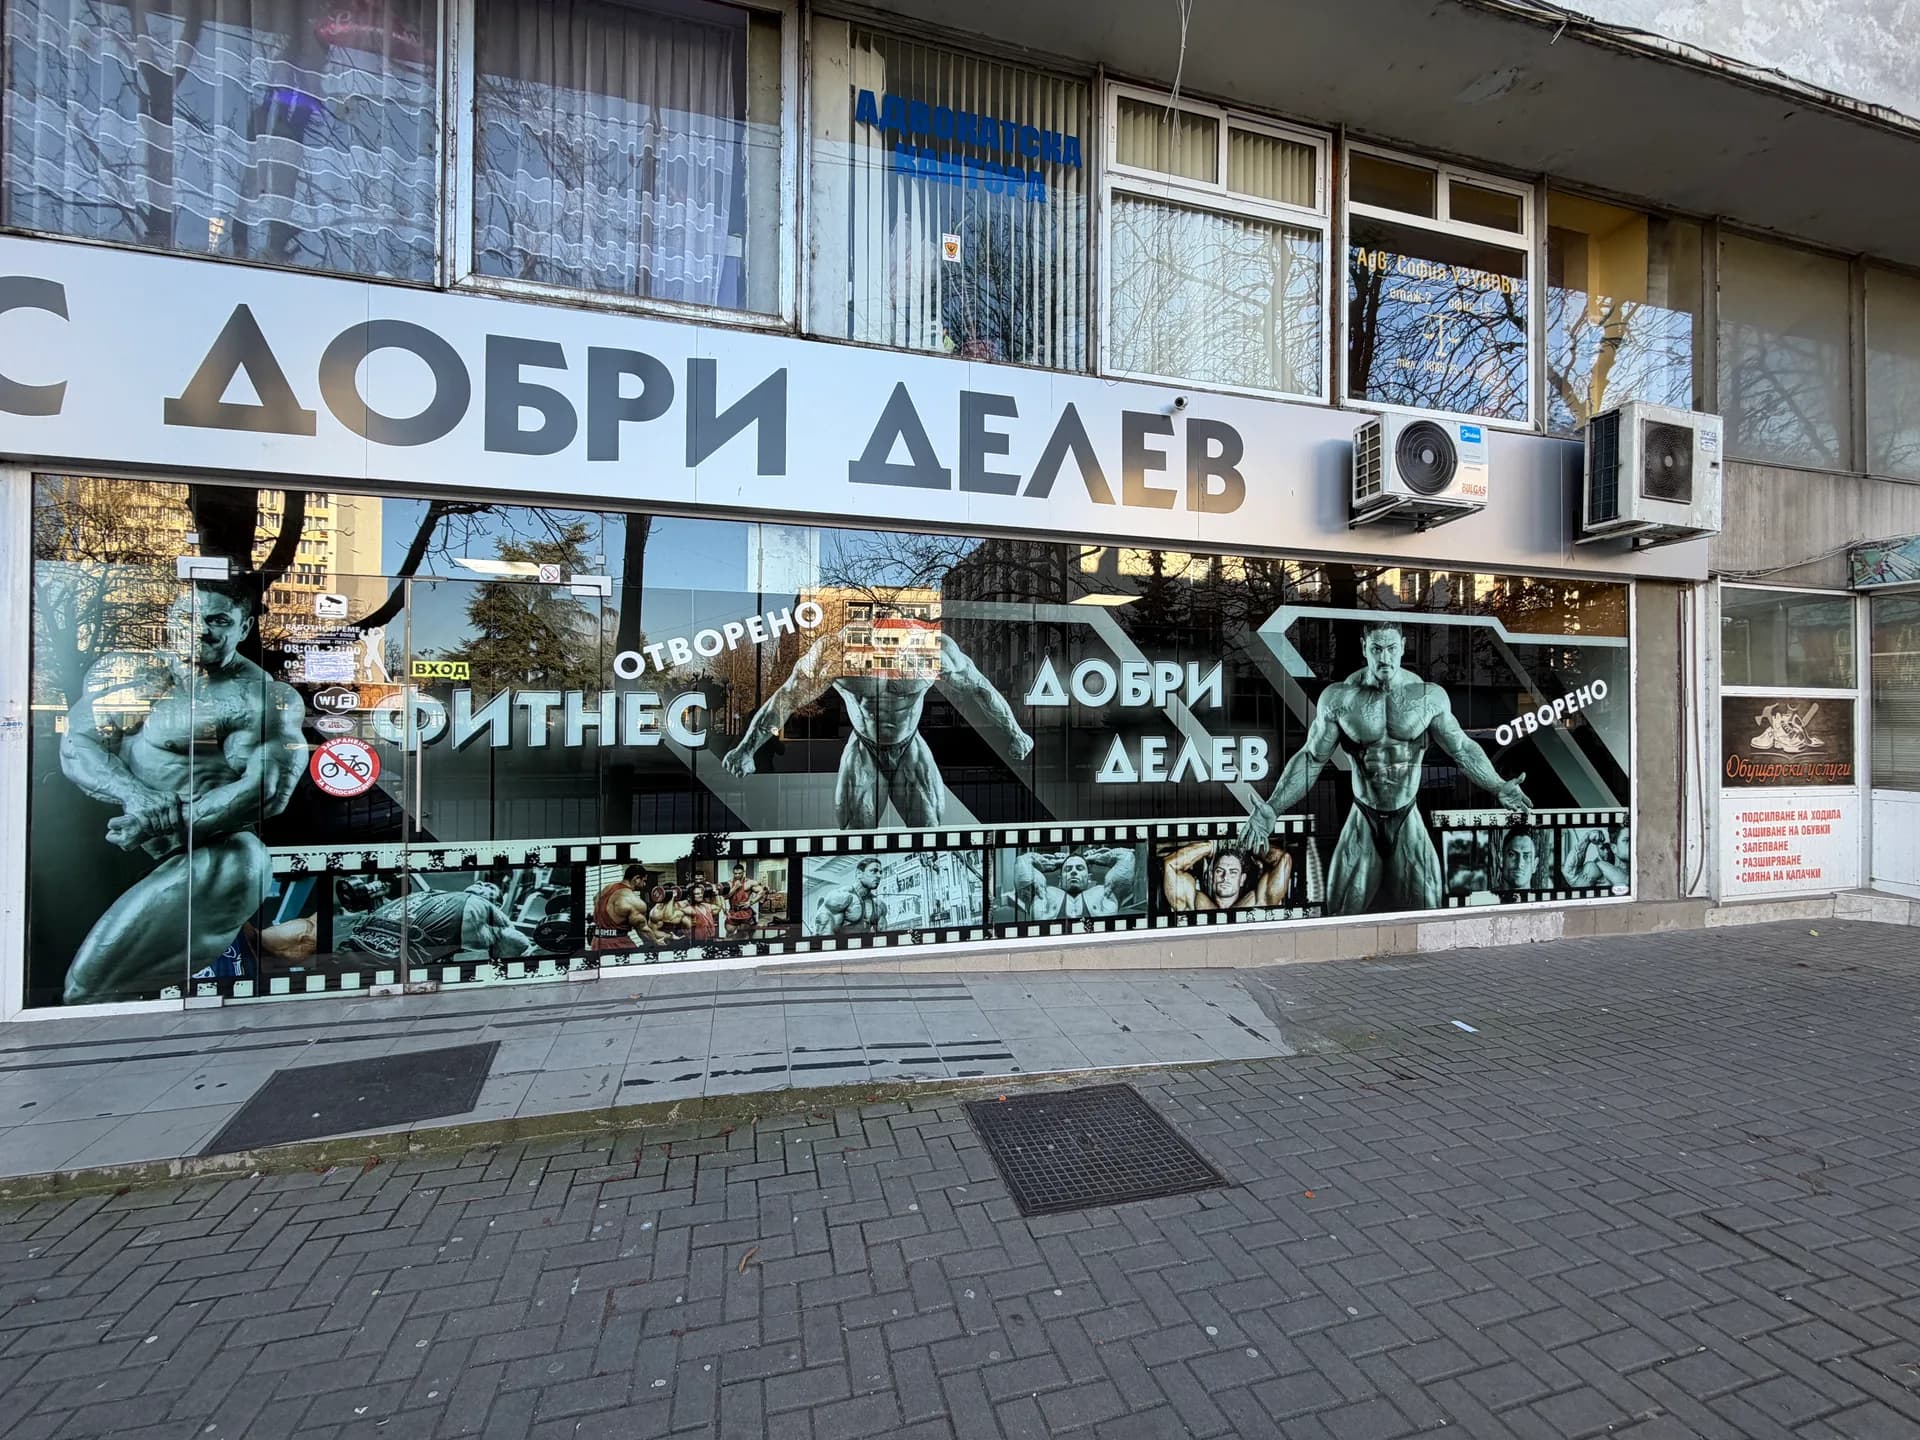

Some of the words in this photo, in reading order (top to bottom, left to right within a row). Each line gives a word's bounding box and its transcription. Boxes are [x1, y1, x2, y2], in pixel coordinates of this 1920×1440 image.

[855, 89, 1082, 168] АДВОКАТСКА
[895, 143, 1047, 203] КАНТОРА
[1397, 255, 1447, 282] София
[164, 303, 787, 476] ДОБРИ
[848, 381, 1246, 514] ДЕЛЕВ
[613, 601, 824, 680] ОТВОРЕНО
[415, 663, 467, 677] ВХОД
[1024, 655, 1222, 709] ДОБРИ
[370, 686, 708, 751] ФИТНЕС
[1495, 679, 1608, 746] ОТВОРЕНО
[1096, 733, 1269, 783] ДЕЛЕВ
[1726, 754, 1804, 783] Обущарски
[1806, 760, 1851, 782] услуги
[1741, 811, 1796, 824] ПОДСИЛВАНЕ
[1797, 810, 1808, 820] НА
[1811, 809, 1841, 821] ХОДИЛА
[1742, 826, 1787, 838] ЗАШИВАНЕ
[1788, 825, 1799, 836] НА
[1801, 824, 1831, 835] ОБУВКИ
[1742, 840, 1789, 853] ЗАЛЕПВАНЕ
[1742, 854, 1802, 868] РАЗШИРЯВАНЕ
[1741, 871, 1771, 883] СМЯНА
[1773, 870, 1784, 881] НА
[1786, 867, 1822, 880] КАПАЧКИ
